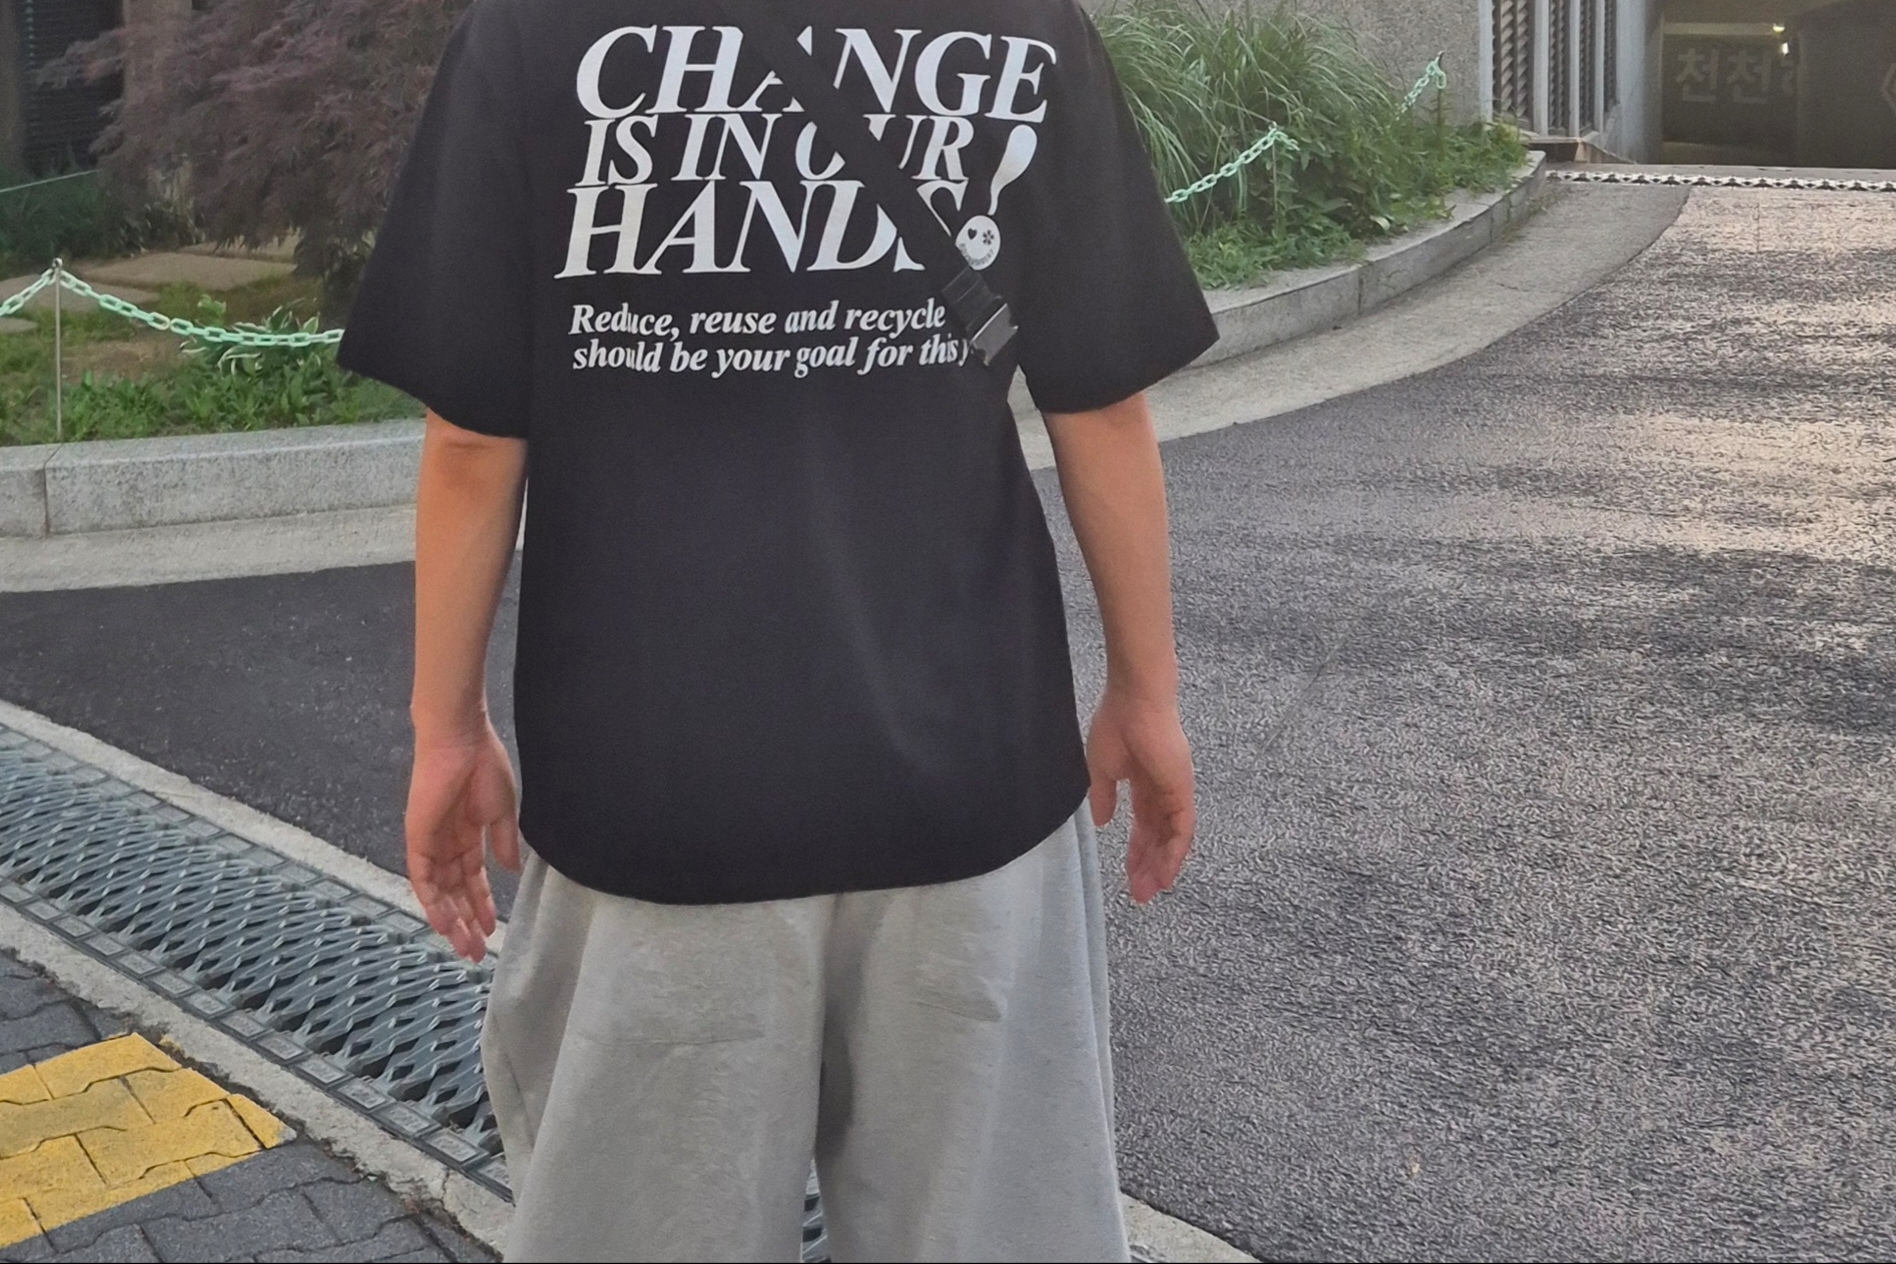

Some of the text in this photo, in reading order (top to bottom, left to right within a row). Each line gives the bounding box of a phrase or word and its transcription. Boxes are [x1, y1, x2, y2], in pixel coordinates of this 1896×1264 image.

[575, 114, 658, 186] IS
[671, 113, 782, 181] IN
[568, 297, 946, 342] Reduce, reuse and recycle
[572, 338, 664, 373] should
[669, 341, 708, 373] be
[711, 348, 790, 379] your
[794, 336, 859, 379] goal
[857, 337, 913, 376] for
